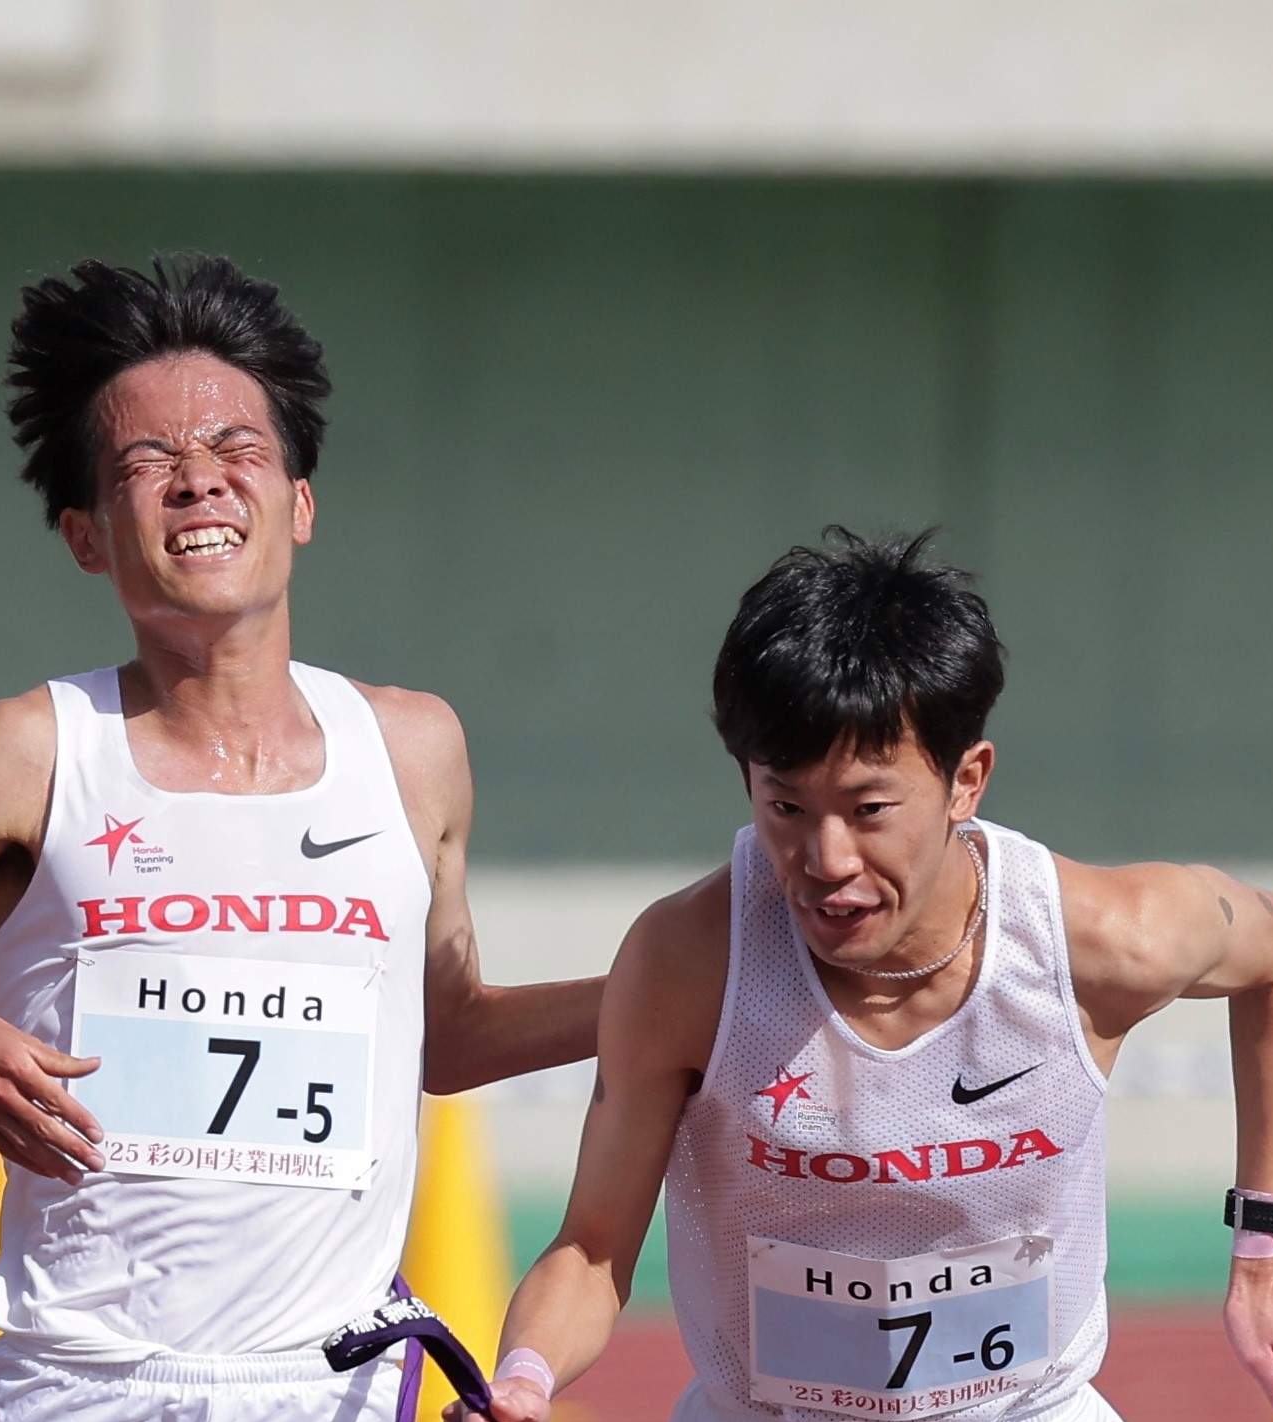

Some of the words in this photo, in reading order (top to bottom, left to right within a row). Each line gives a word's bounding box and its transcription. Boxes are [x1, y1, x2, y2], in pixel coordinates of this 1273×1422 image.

[132, 846, 164, 855] Honda
[133, 855, 174, 865] Running
[134, 865, 162, 874] Team
[77, 894, 390, 942] HONDA
[138, 978, 323, 1021] Honda
[797, 1112, 836, 1125] Running
[798, 1101, 829, 1112] Honda
[797, 1121, 823, 1132] Team
[147, 1142, 335, 1179] 彩の国実業団駅伝
[747, 1129, 1065, 1184] HONDA
[805, 1265, 993, 1302] Honda
[831, 1373, 1020, 1415] 彩の国実業団駅伝
